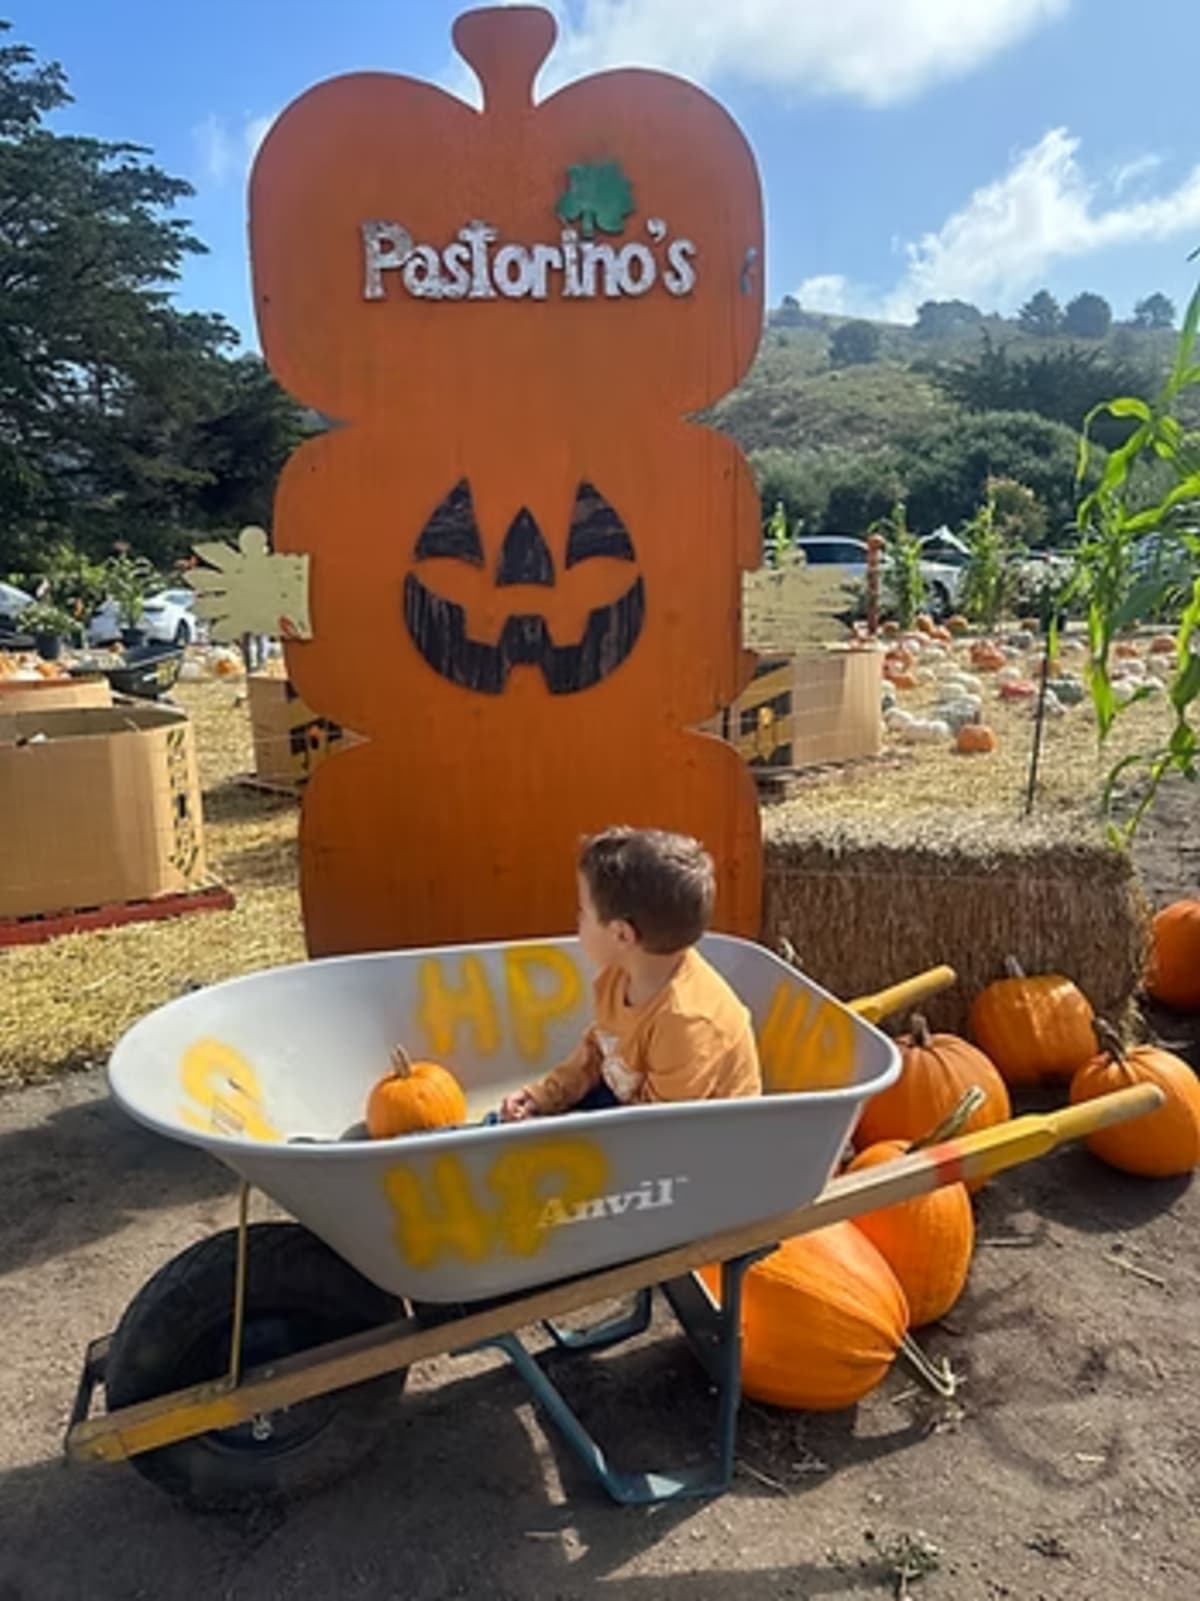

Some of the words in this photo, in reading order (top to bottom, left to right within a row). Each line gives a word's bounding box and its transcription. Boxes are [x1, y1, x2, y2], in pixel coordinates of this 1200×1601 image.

[363, 216, 697, 300] Pastorino's
[417, 944, 582, 1062] HP
[384, 1138, 610, 1267] HP
[536, 1177, 675, 1229] Anvil
